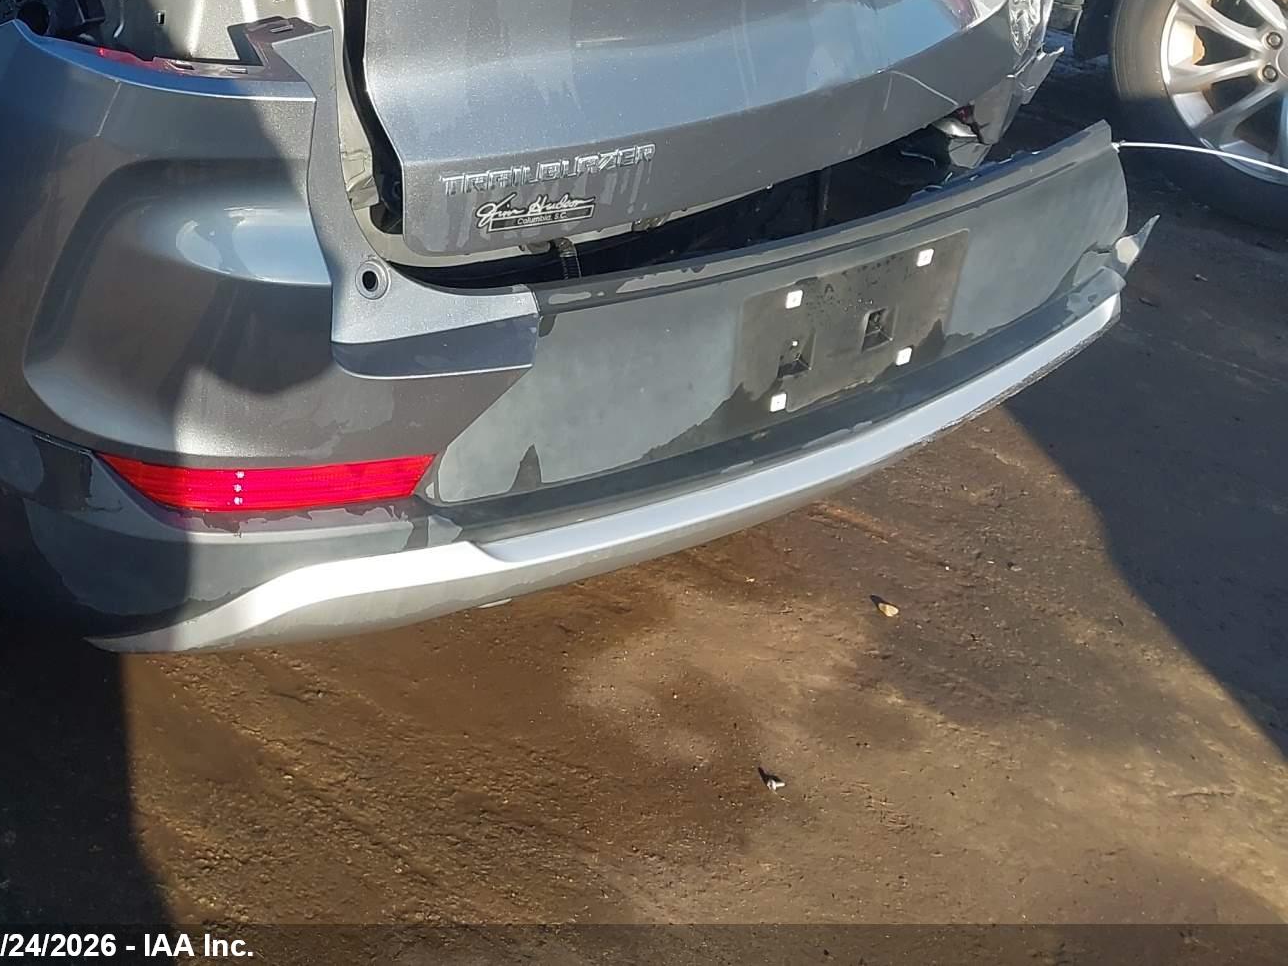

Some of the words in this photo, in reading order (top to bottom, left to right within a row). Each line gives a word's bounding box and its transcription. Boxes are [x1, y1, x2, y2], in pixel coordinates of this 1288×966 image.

[439, 143, 656, 196] TRAILBLAZER
[476, 193, 525, 228] Jim
[527, 193, 596, 215] Hudson
